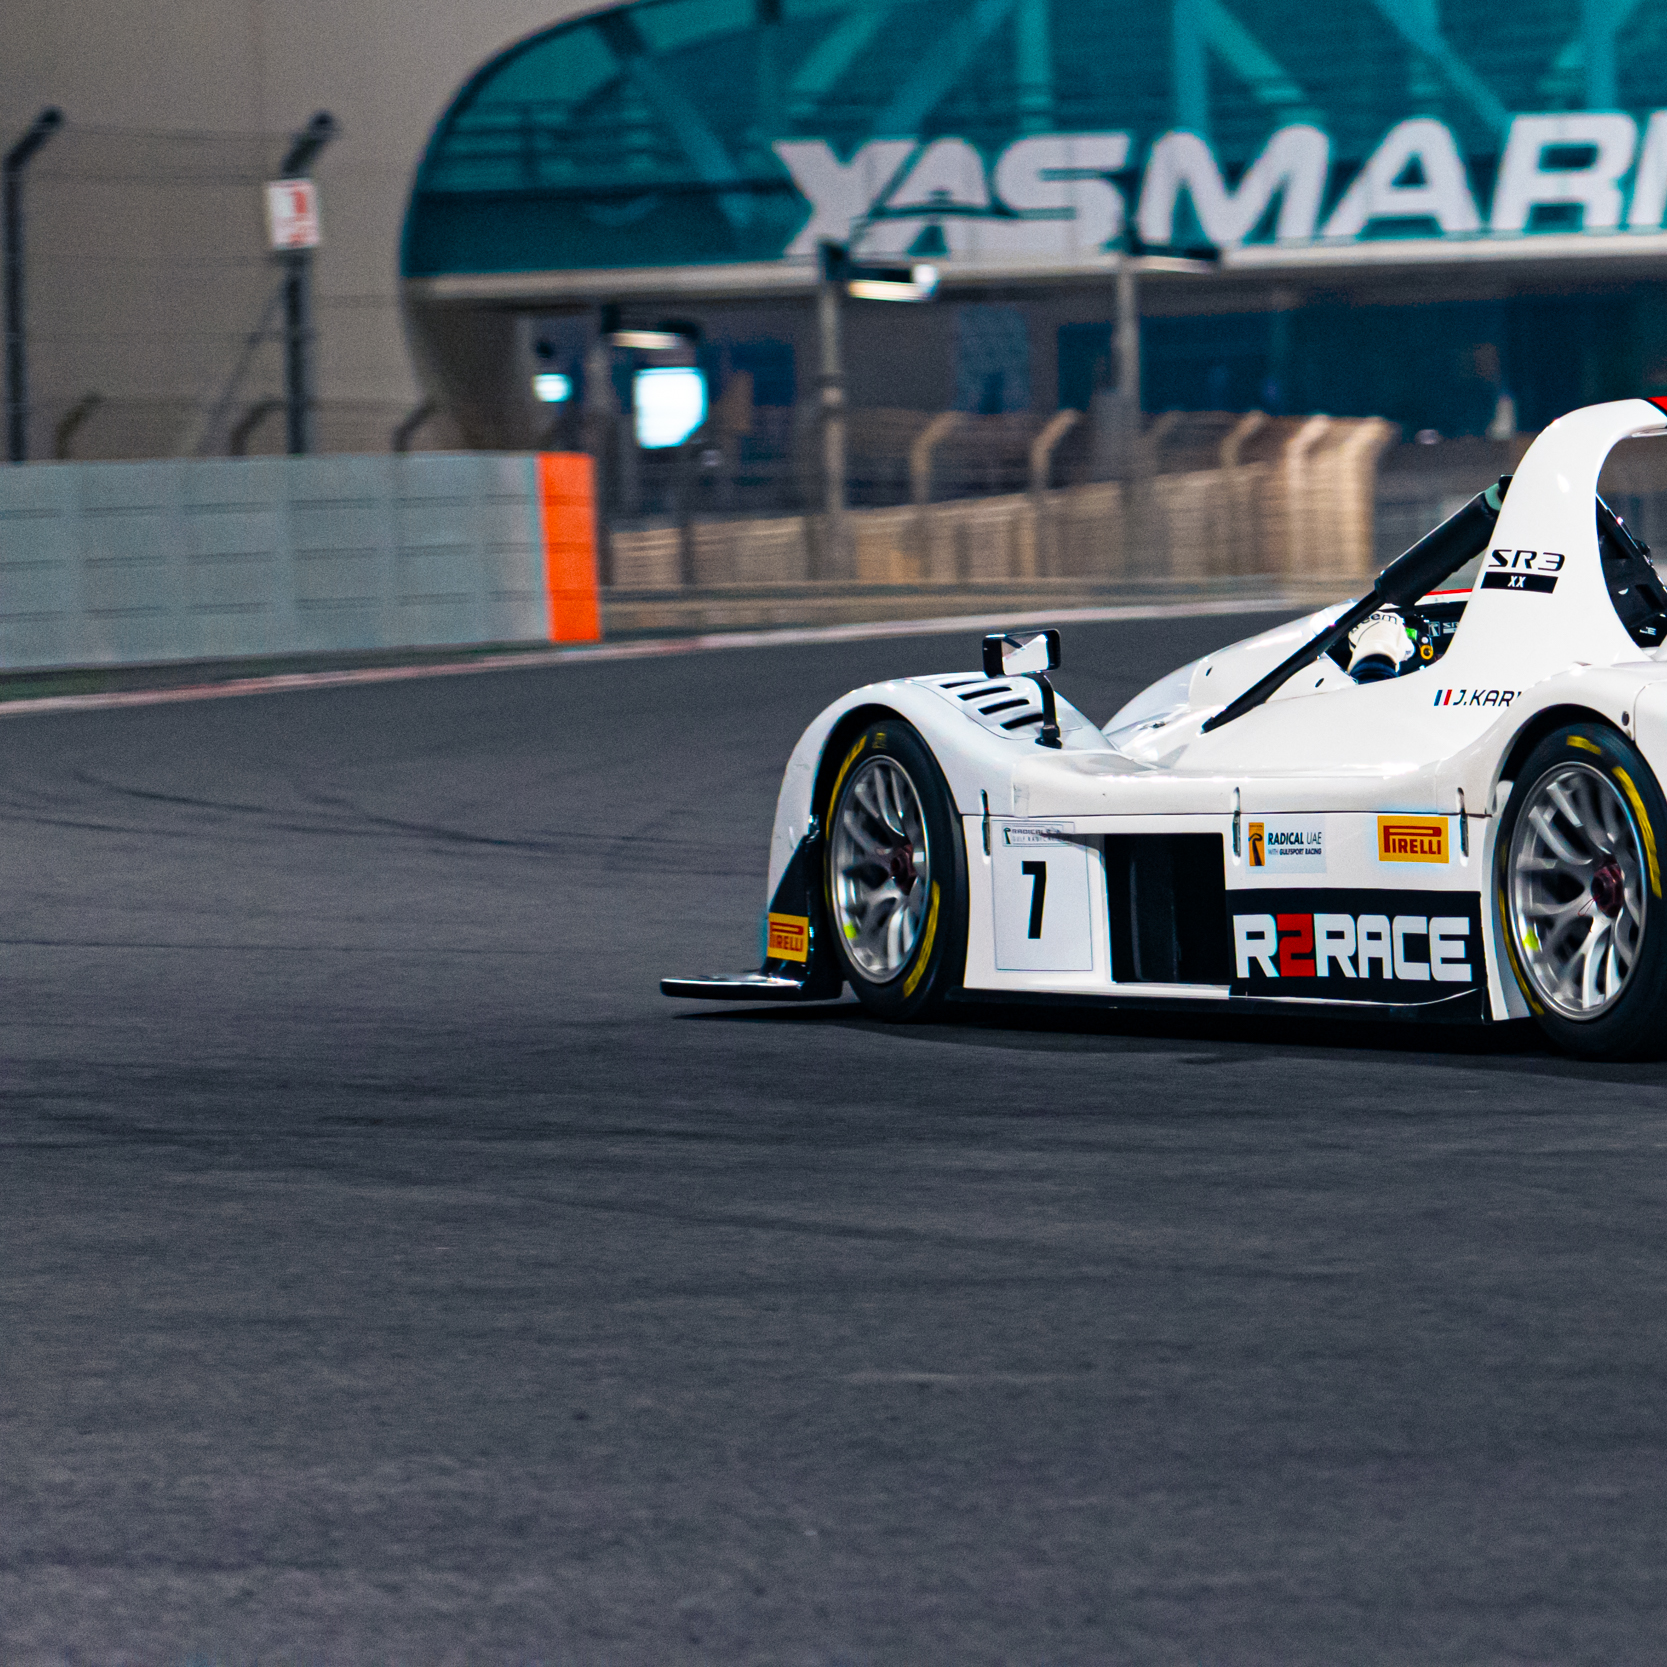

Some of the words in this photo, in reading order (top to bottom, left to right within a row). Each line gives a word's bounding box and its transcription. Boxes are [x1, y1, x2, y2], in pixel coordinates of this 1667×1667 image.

[771, 131, 1132, 260] YAS
[1488, 549, 1566, 572] SR3
[1507, 575, 1527, 588] XX
[1453, 689, 1522, 707] J.KAR
[1268, 832, 1304, 845] RADICAL
[1306, 832, 1322, 845] UAE
[1383, 825, 1442, 855] PIRELLI
[1022, 861, 1047, 939] 7
[769, 921, 804, 953] PIRELLI
[1233, 913, 1473, 982] R2RACE
